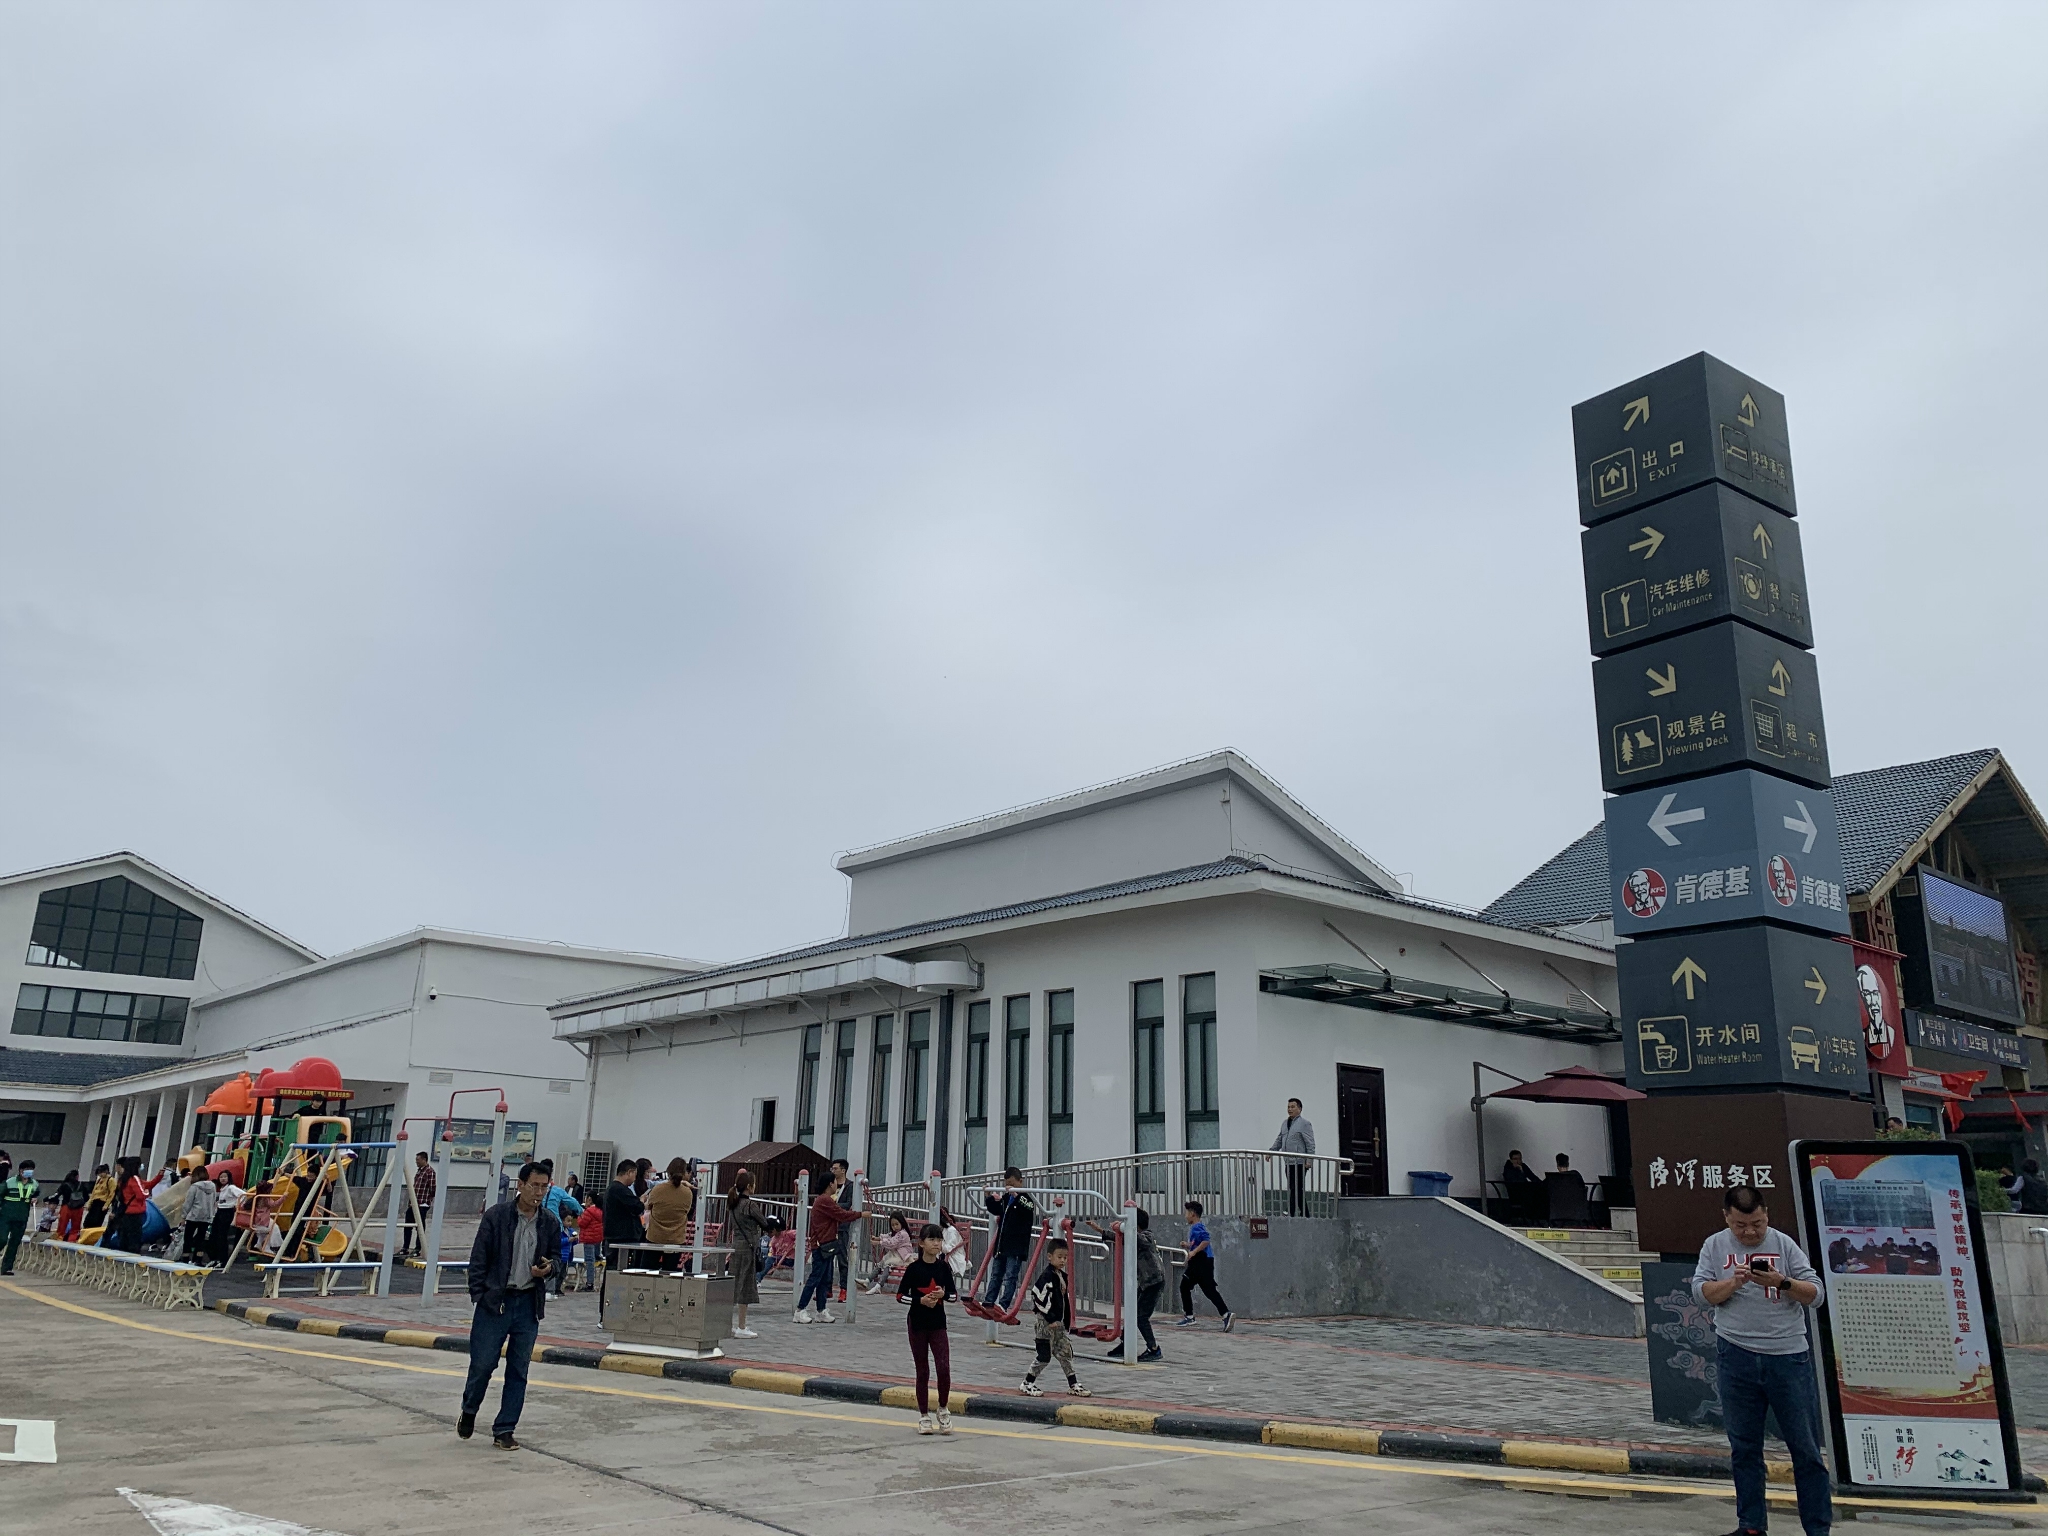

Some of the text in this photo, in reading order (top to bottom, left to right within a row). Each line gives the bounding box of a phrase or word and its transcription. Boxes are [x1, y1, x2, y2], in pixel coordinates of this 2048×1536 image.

[1642, 440, 1684, 469] 出口
[1649, 462, 1678, 482] EXIT
[1649, 568, 1711, 603] 汽车维修
[1652, 592, 1713, 617] Car Maintenance
[1666, 711, 1726, 740] 观景台
[1786, 722, 1818, 748] 超市
[1665, 733, 1729, 757] Viewing Deck
[1650, 886, 1665, 894] KFC
[1674, 865, 1750, 905] 肯德基
[1786, 878, 1796, 886] KFC
[1801, 875, 1842, 912] 肯德基
[1696, 1023, 1761, 1047] 开水间
[1823, 1035, 1858, 1059] 小车停车
[1967, 1033, 1989, 1052] 卫生间
[1696, 1051, 1763, 1065] Water Heater Room
[1950, 1266, 1972, 1333] 助力脱贫攻坚
